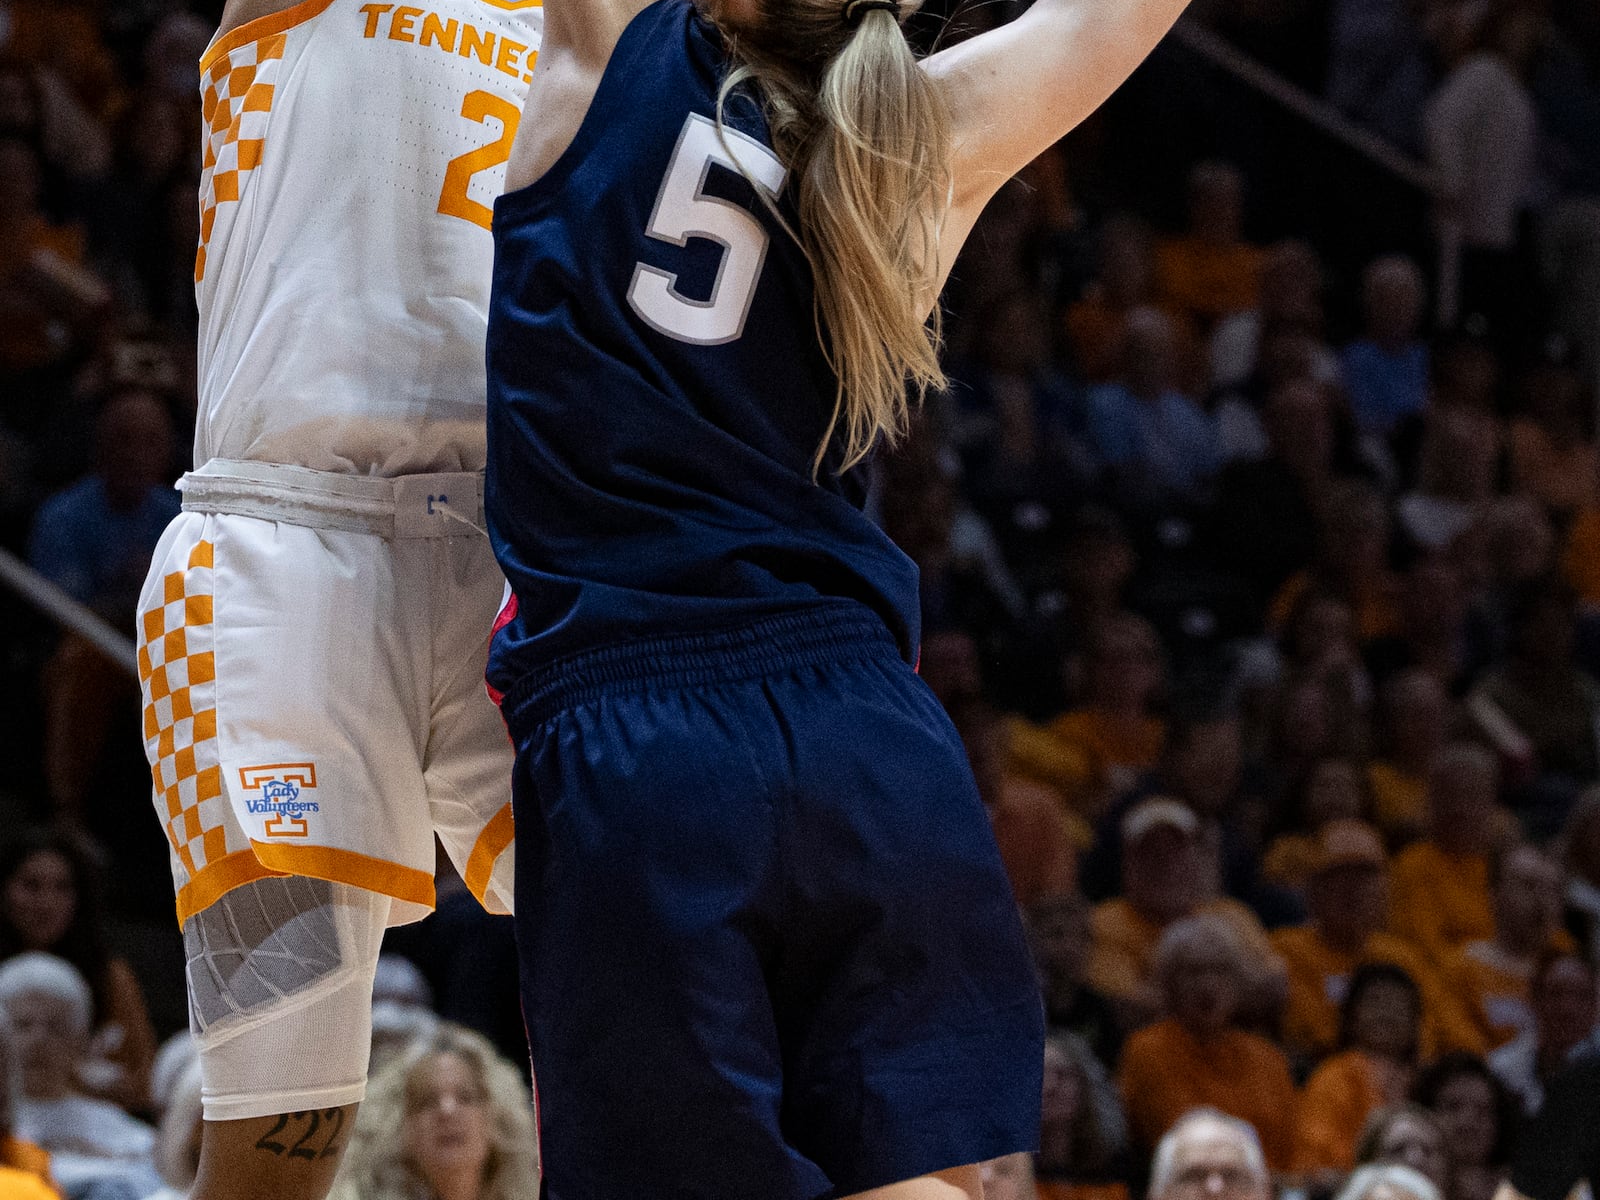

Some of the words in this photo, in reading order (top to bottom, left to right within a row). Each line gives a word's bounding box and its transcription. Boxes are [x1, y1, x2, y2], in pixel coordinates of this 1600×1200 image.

[437, 89, 522, 232] 2
[626, 111, 787, 346] 5
[246, 798, 319, 819] Volunteers
[263, 780, 299, 801] Lady
